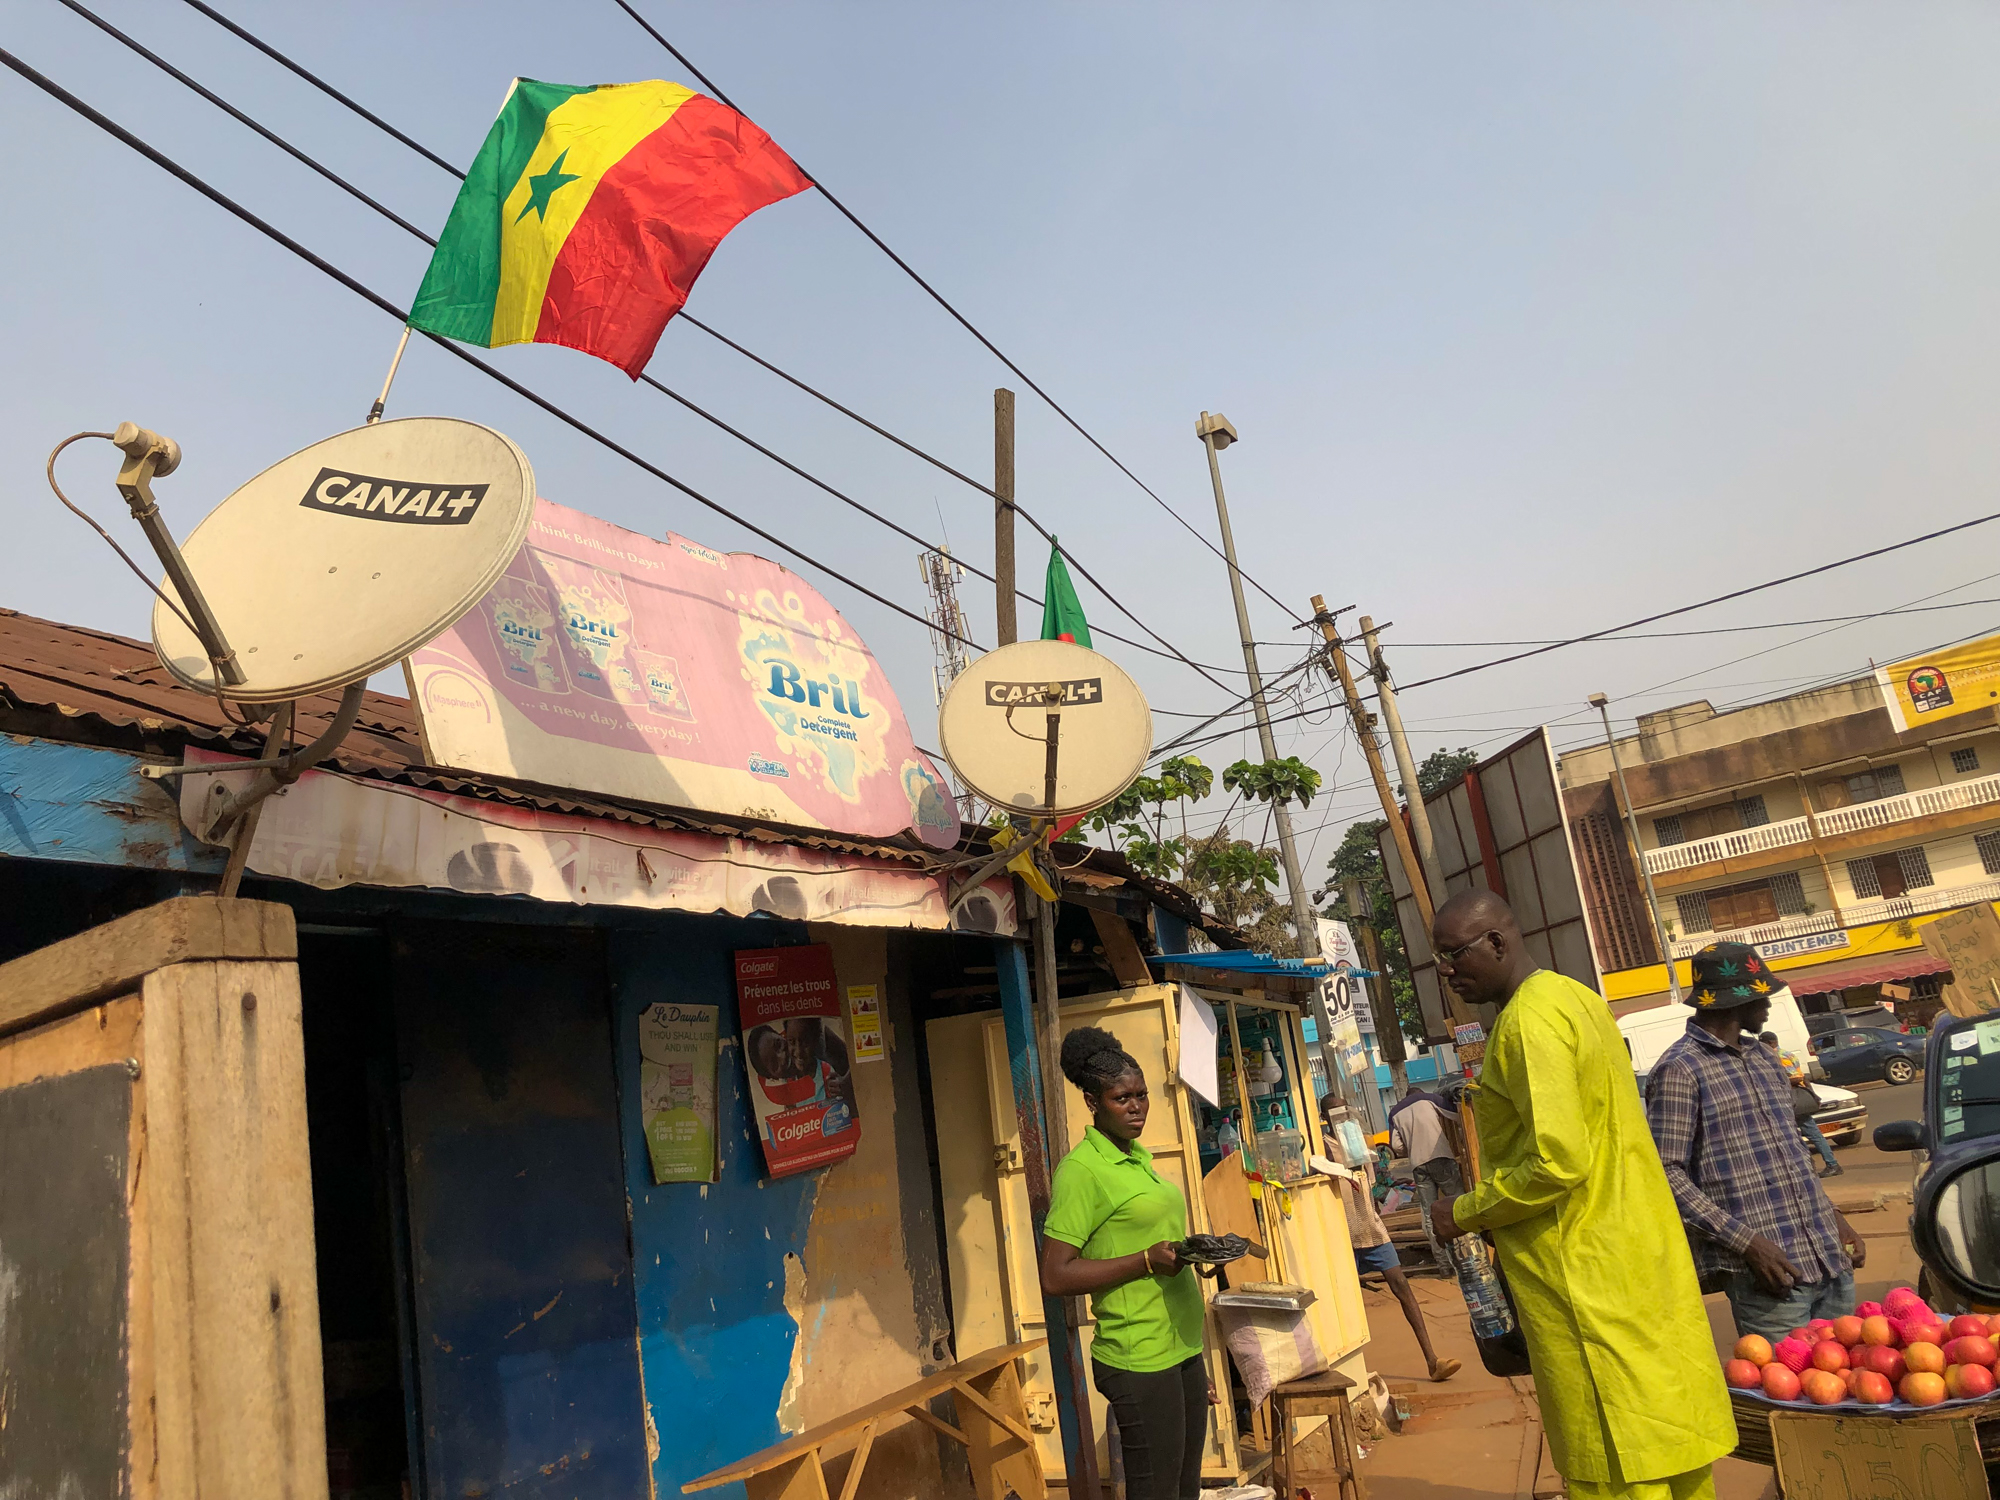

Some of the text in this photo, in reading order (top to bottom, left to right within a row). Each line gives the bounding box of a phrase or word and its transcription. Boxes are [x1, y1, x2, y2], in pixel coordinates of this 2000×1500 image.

[316, 476, 477, 518] CANAL+
[532, 520, 571, 542] Think
[574, 533, 625, 561] Brilliant
[627, 552, 659, 571] Days
[503, 620, 544, 641] Bril
[570, 612, 619, 638] Bril
[581, 636, 611, 648] Detergent
[651, 677, 673, 691] Bril
[763, 658, 870, 719] Bril
[990, 682, 1098, 703] CANL+
[539, 702, 550, 711] a
[553, 704, 586, 720] new
[590, 710, 623, 730] day,
[626, 721, 693, 744] everyday
[800, 717, 858, 742] Detergent
[817, 715, 851, 729] Complete
[604, 859, 620, 873] all
[1762, 932, 1847, 957] PRINTEMPS
[740, 961, 775, 975] Colgate
[744, 979, 831, 999] Prévenez les trous
[1323, 976, 1351, 1017] 50
[757, 996, 823, 1015] dans les dents
[652, 1006, 711, 1028] Le Dauphin
[649, 1030, 716, 1042] THOU SHALL USE
[664, 1043, 698, 1053] AND WIN
[770, 1104, 816, 1121] Colgate
[777, 1118, 821, 1142] Colgate
